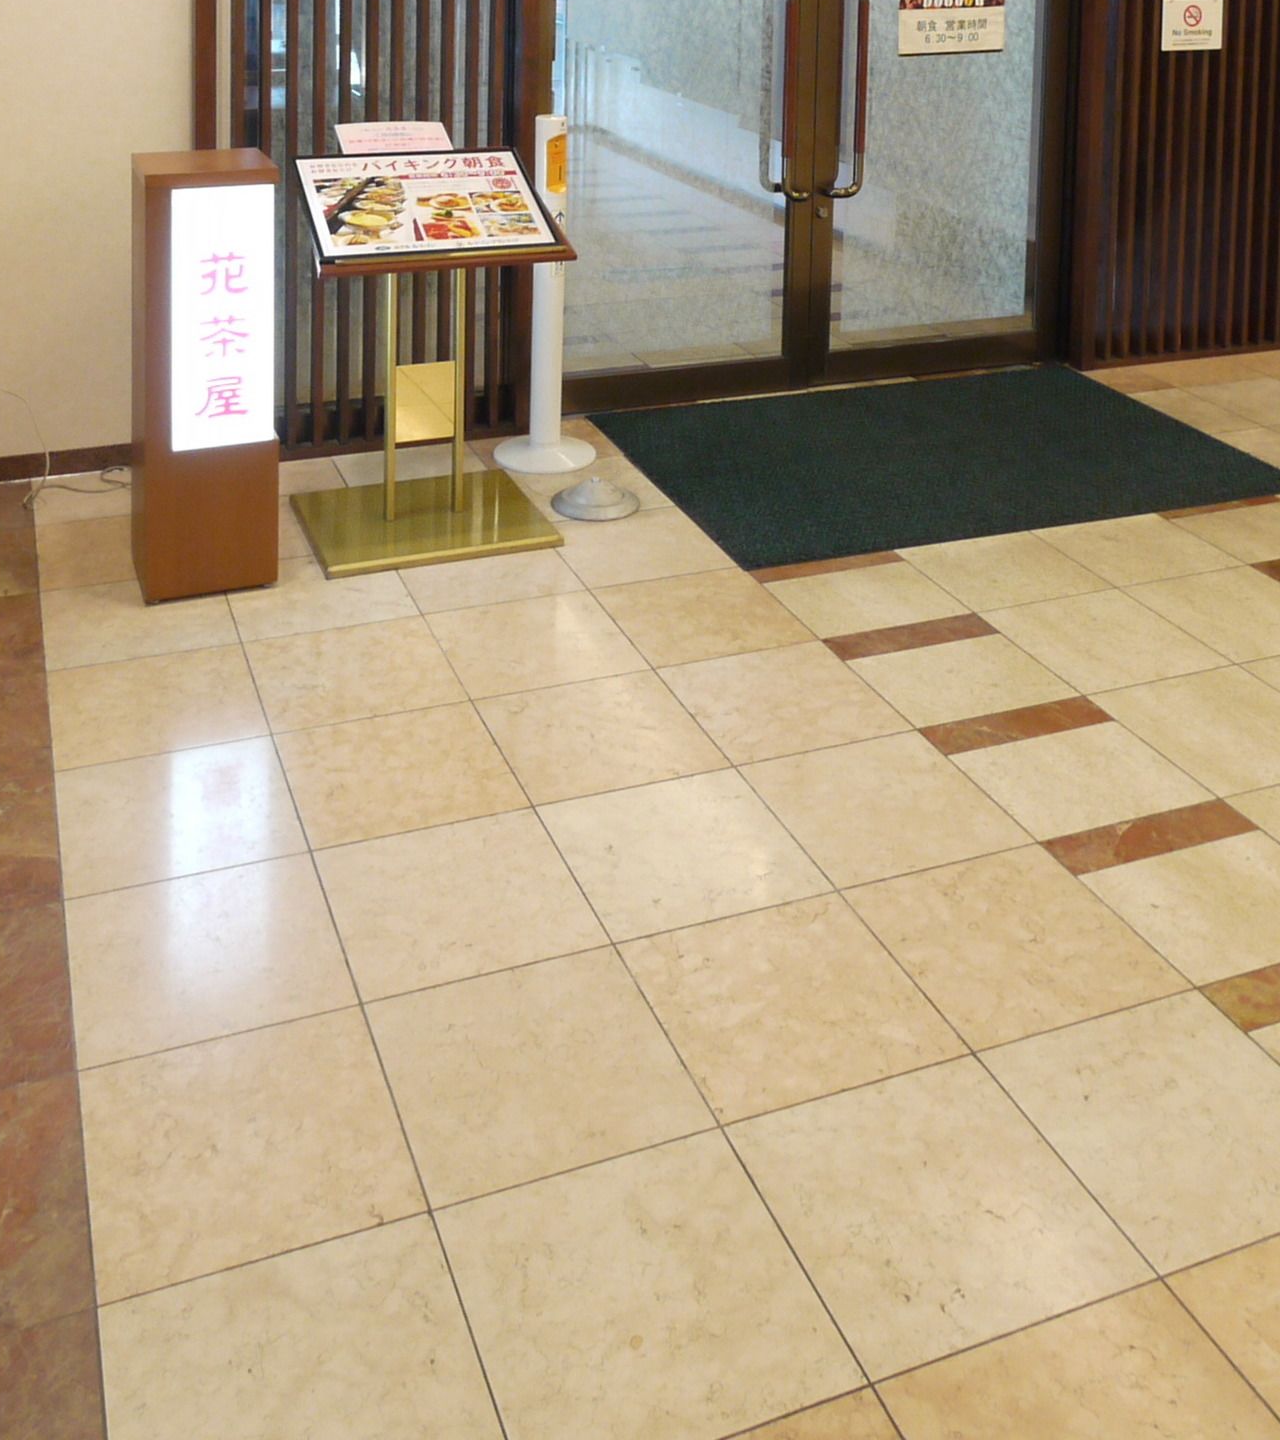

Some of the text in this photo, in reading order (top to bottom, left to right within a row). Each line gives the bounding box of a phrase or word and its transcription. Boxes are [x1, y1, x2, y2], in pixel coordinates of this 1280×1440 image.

[917, 19, 987, 32] 朝食 営業時間
[362, 156, 505, 172] バイキング朝食
[195, 252, 249, 418] 花茶屋
